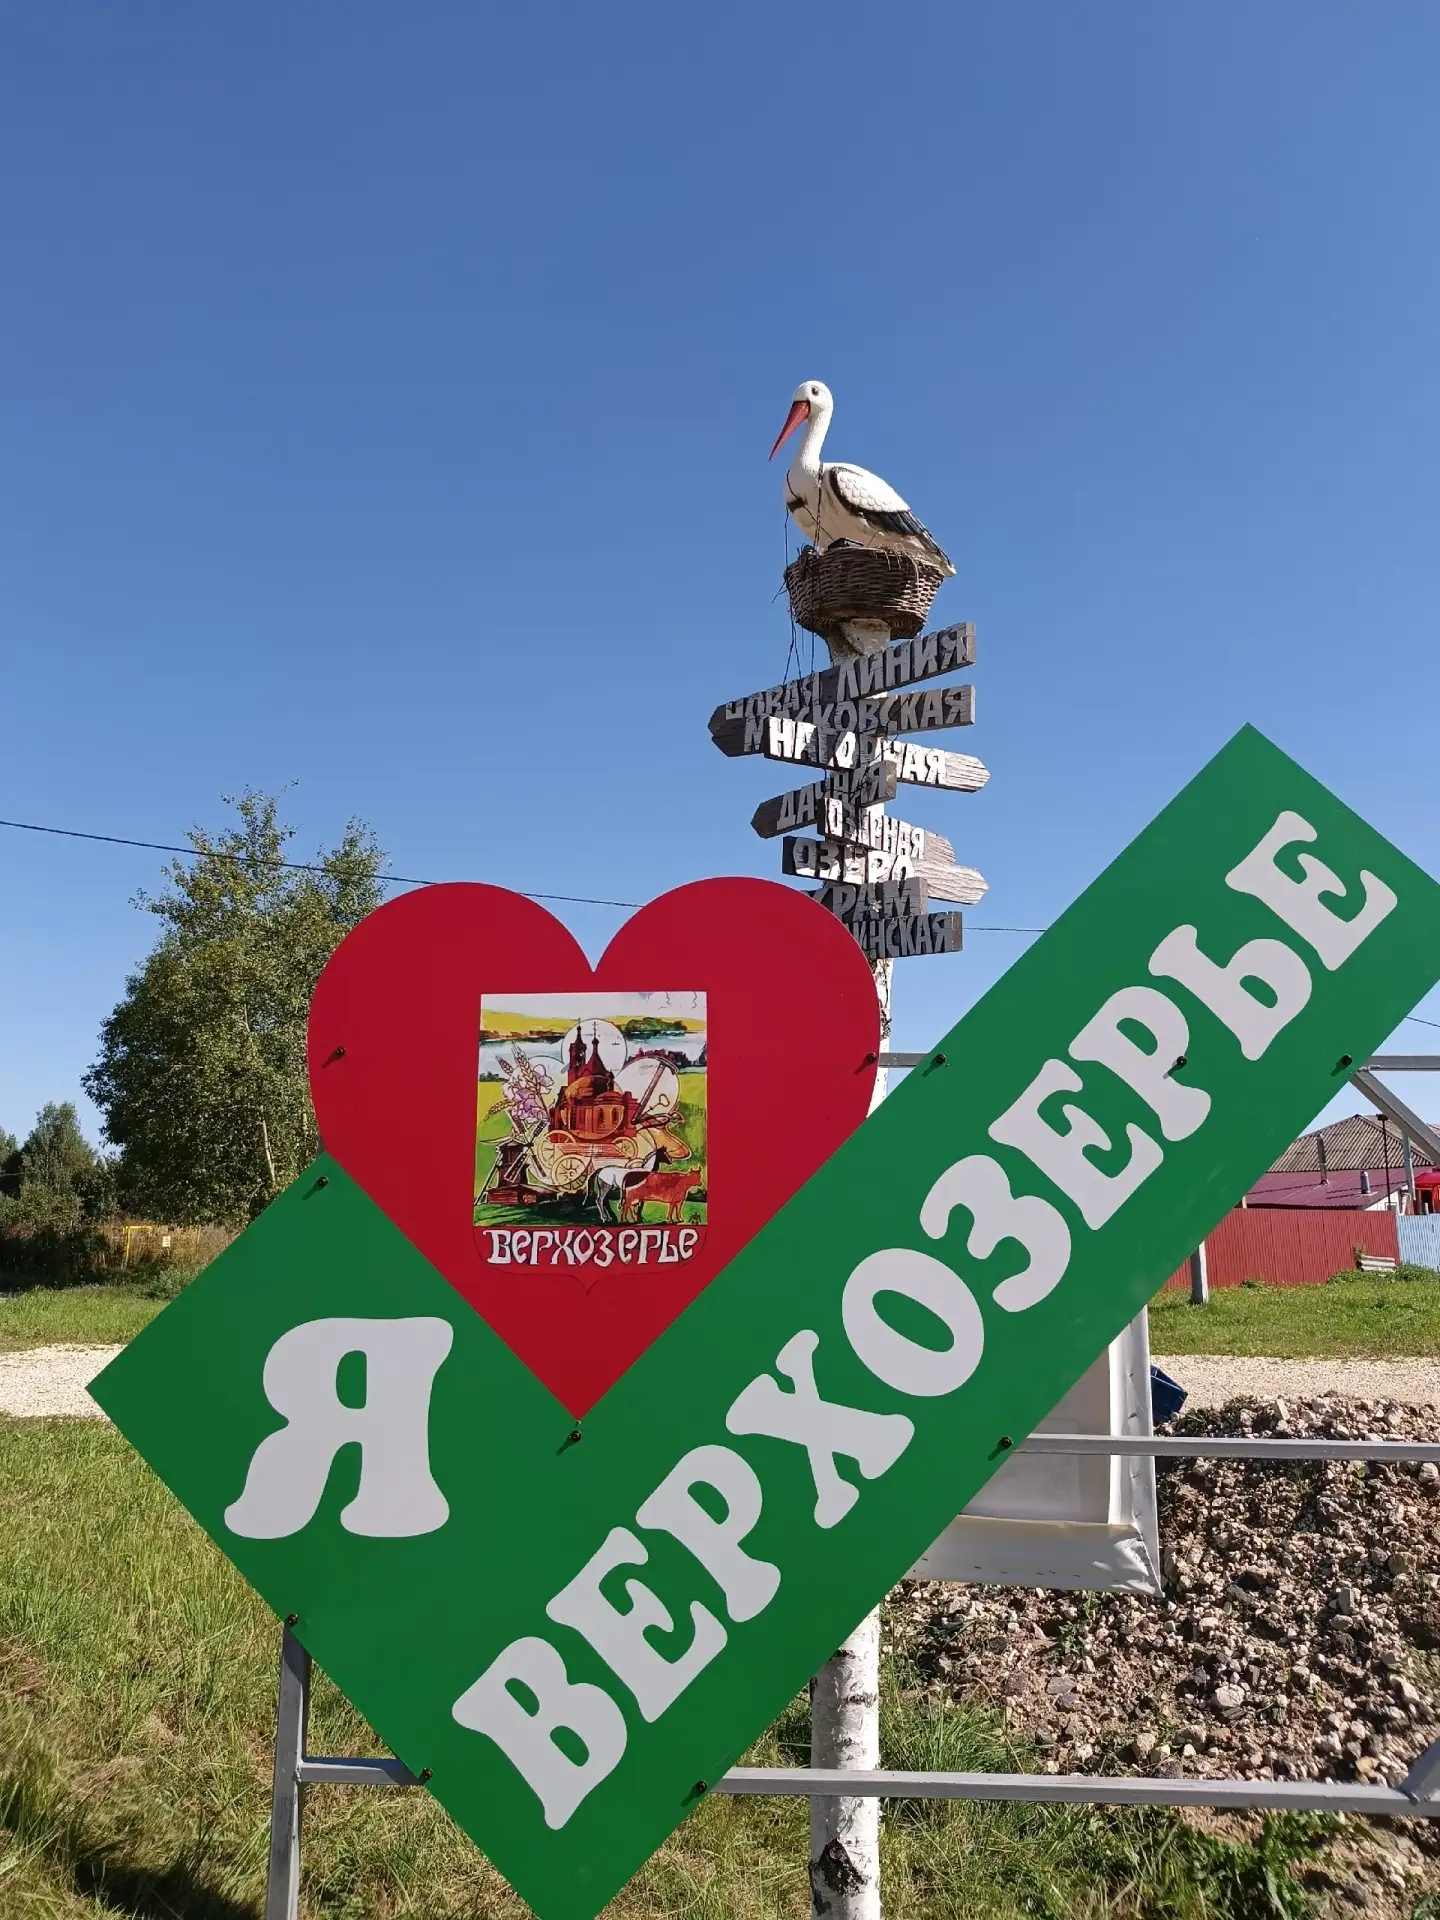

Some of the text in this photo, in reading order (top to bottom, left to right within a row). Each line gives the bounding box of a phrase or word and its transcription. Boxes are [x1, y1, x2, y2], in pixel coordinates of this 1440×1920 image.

[837, 621, 966, 702] ЛИНИЯ
[793, 837, 914, 884] ОЗЕРО
[452, 810, 1398, 1830] ВЕРХОЗЕРЬЕ
[224, 1317, 454, 1539] Я
